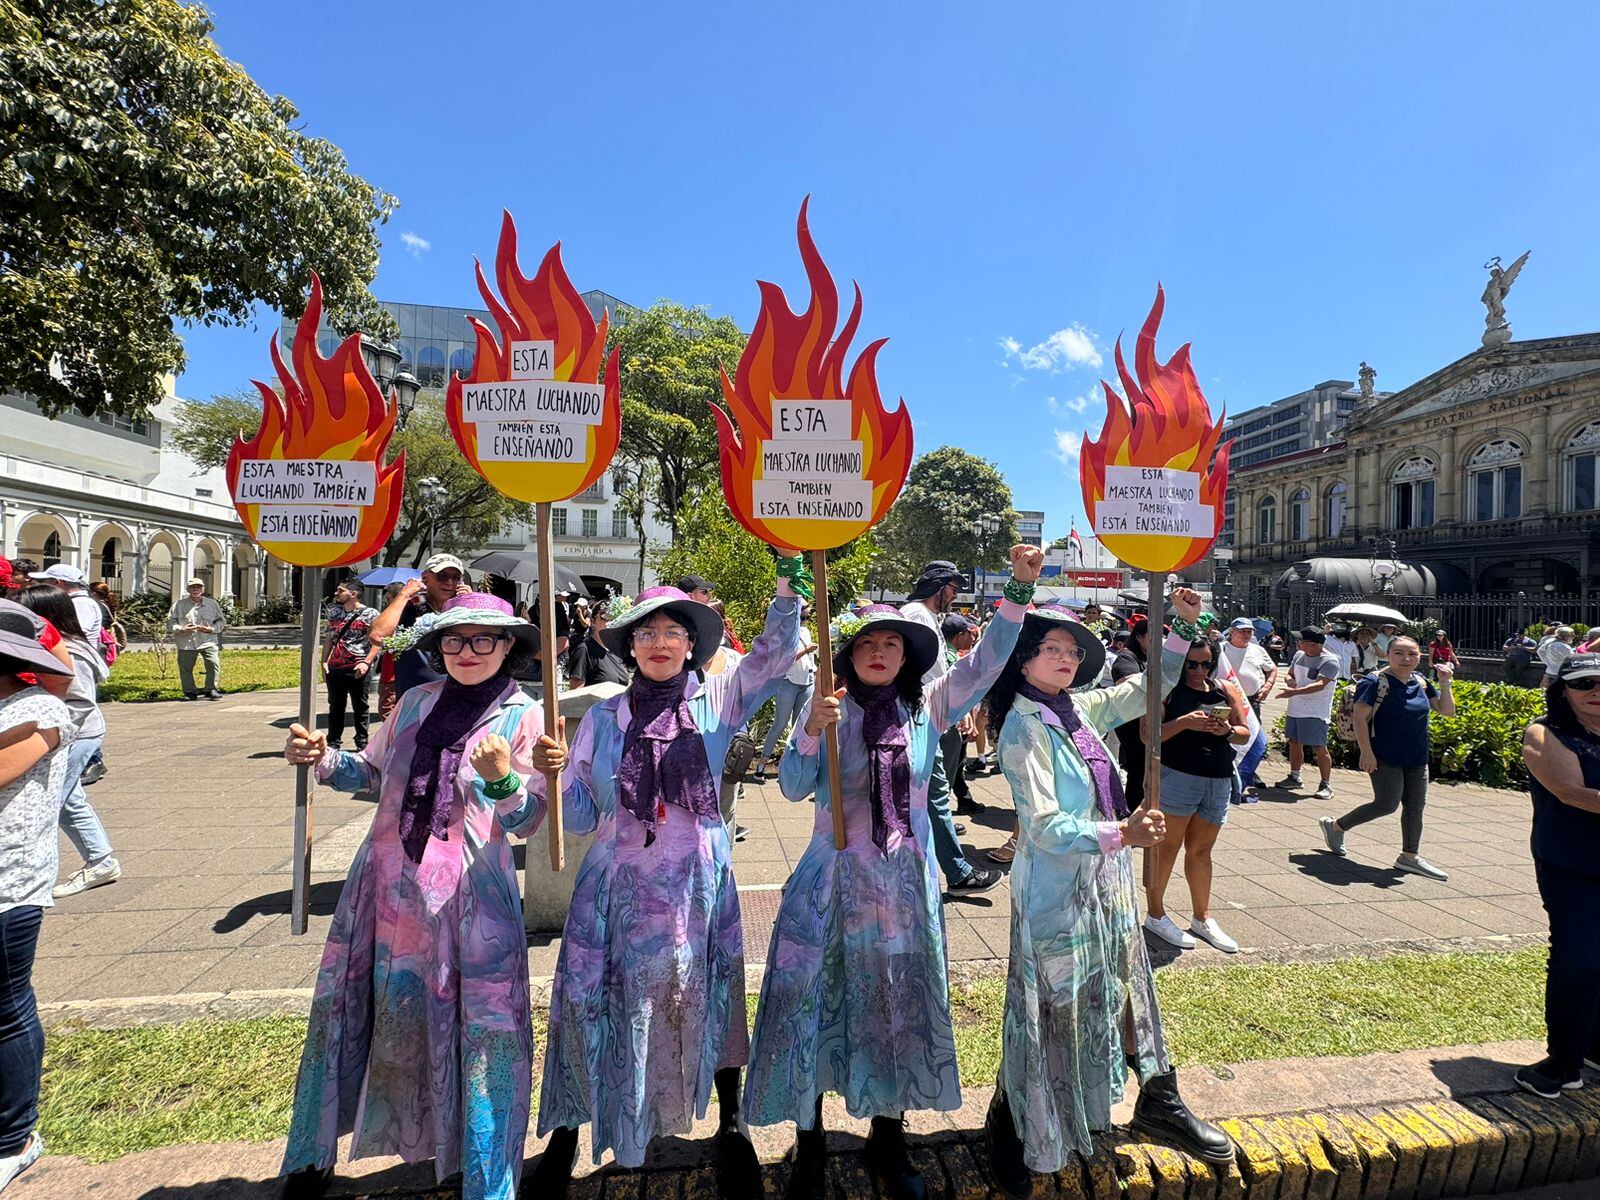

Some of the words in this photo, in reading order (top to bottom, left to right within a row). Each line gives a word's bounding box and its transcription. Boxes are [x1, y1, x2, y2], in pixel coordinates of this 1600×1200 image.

[513, 348, 549, 372] ESTA
[467, 387, 526, 412] MAESTRA
[536, 387, 601, 416] LUCHANDO
[1424, 410, 1473, 428] TEATRO
[1488, 388, 1569, 414] NACIONAL
[539, 422, 561, 436] ESTÁ
[780, 407, 827, 433] ESTA
[494, 435, 573, 460] ENSEÑANDO
[243, 462, 275, 478] ESTA
[286, 461, 343, 479] MAESTRA
[763, 451, 811, 472] MAESTRA
[815, 452, 861, 474] LUCHANDO
[1141, 468, 1163, 480] ESTA
[241, 482, 305, 500] LUCHANDO
[1108, 485, 1153, 500] MAESTRA
[1159, 486, 1194, 501] LUCHANDO
[760, 499, 790, 516] ESTÁ
[797, 498, 864, 518] ENSEÑANDO
[261, 511, 289, 533] ESTÁ
[293, 510, 358, 538] ENSEÑANDO
[1102, 513, 1128, 531] ESTÁ
[1136, 517, 1191, 533] ENSEÑANDO
